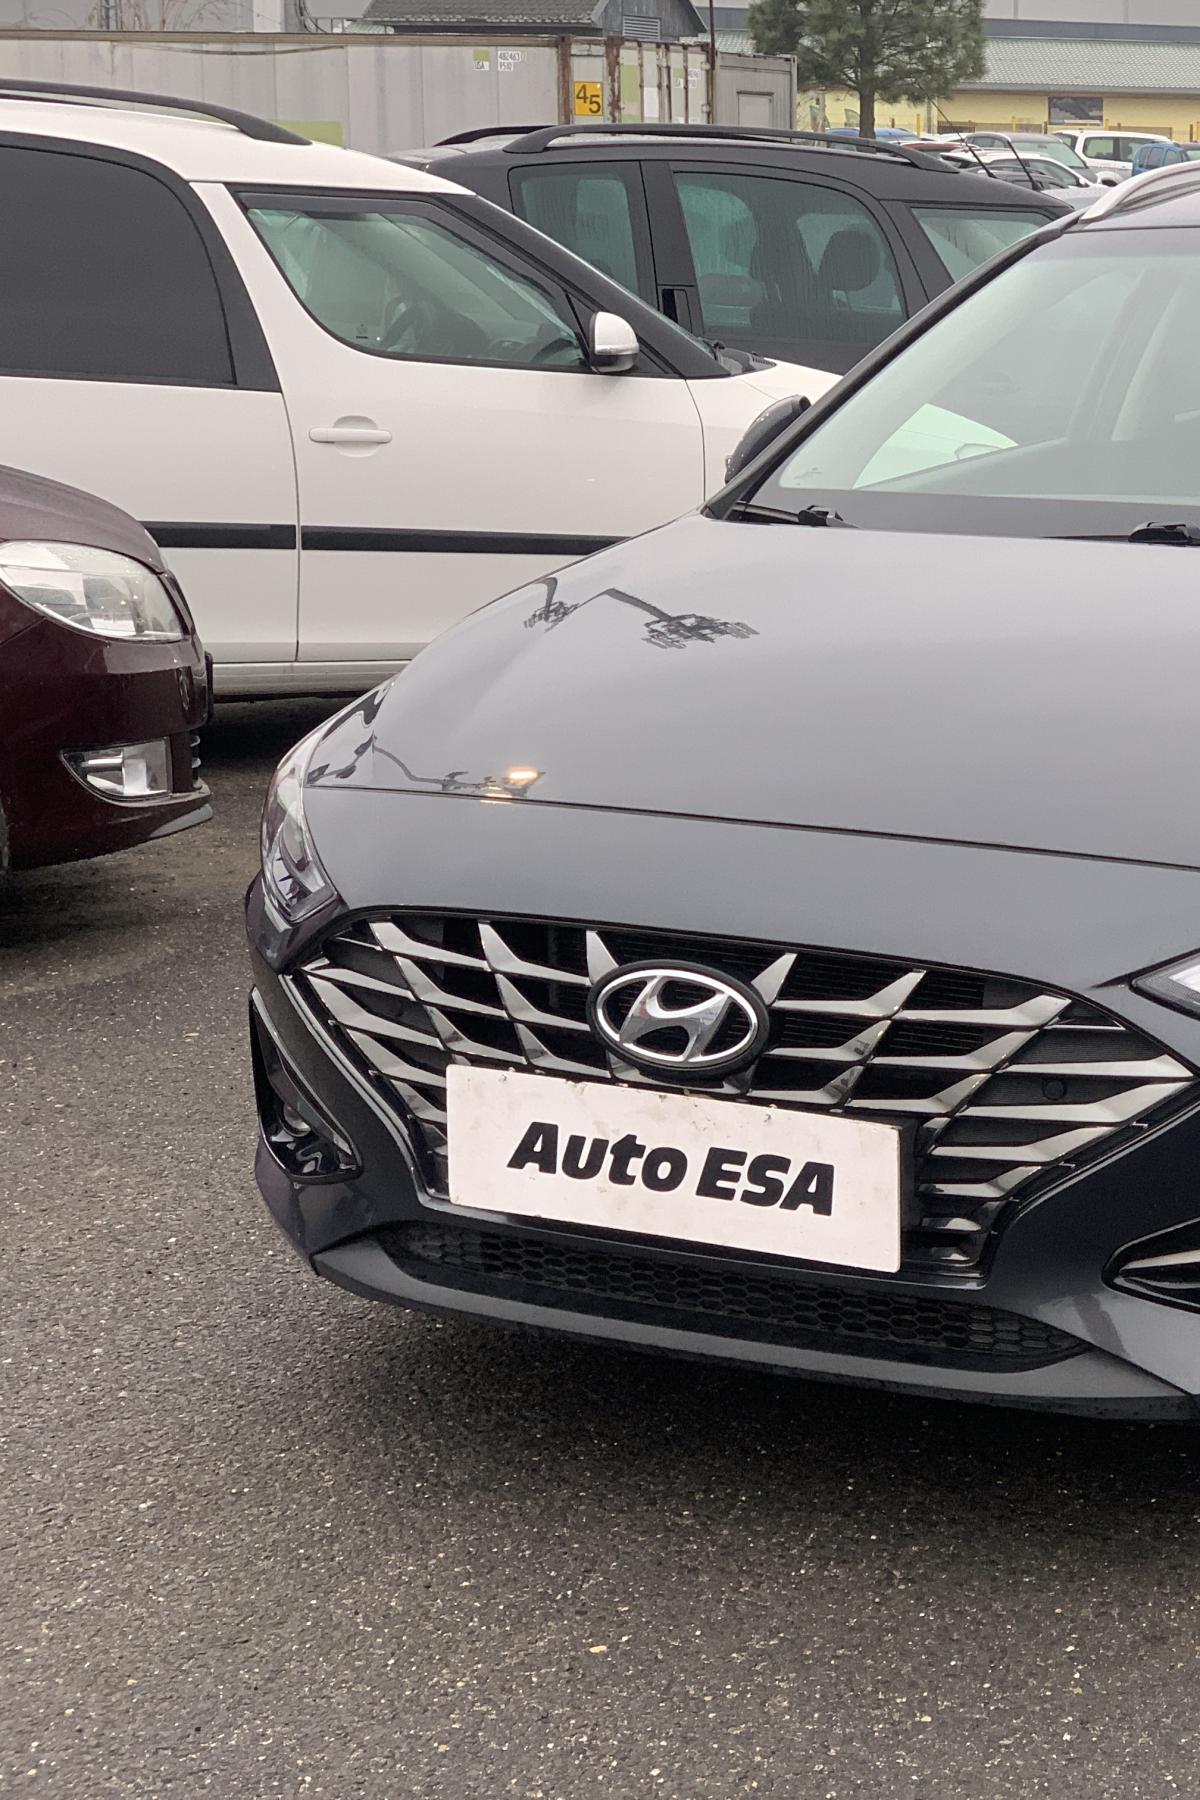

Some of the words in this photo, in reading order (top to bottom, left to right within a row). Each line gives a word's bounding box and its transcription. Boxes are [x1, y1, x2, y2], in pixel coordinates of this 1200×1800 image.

[575, 84, 602, 114] 45
[507, 1122, 688, 1192] Auto
[695, 1147, 835, 1217] ESA
